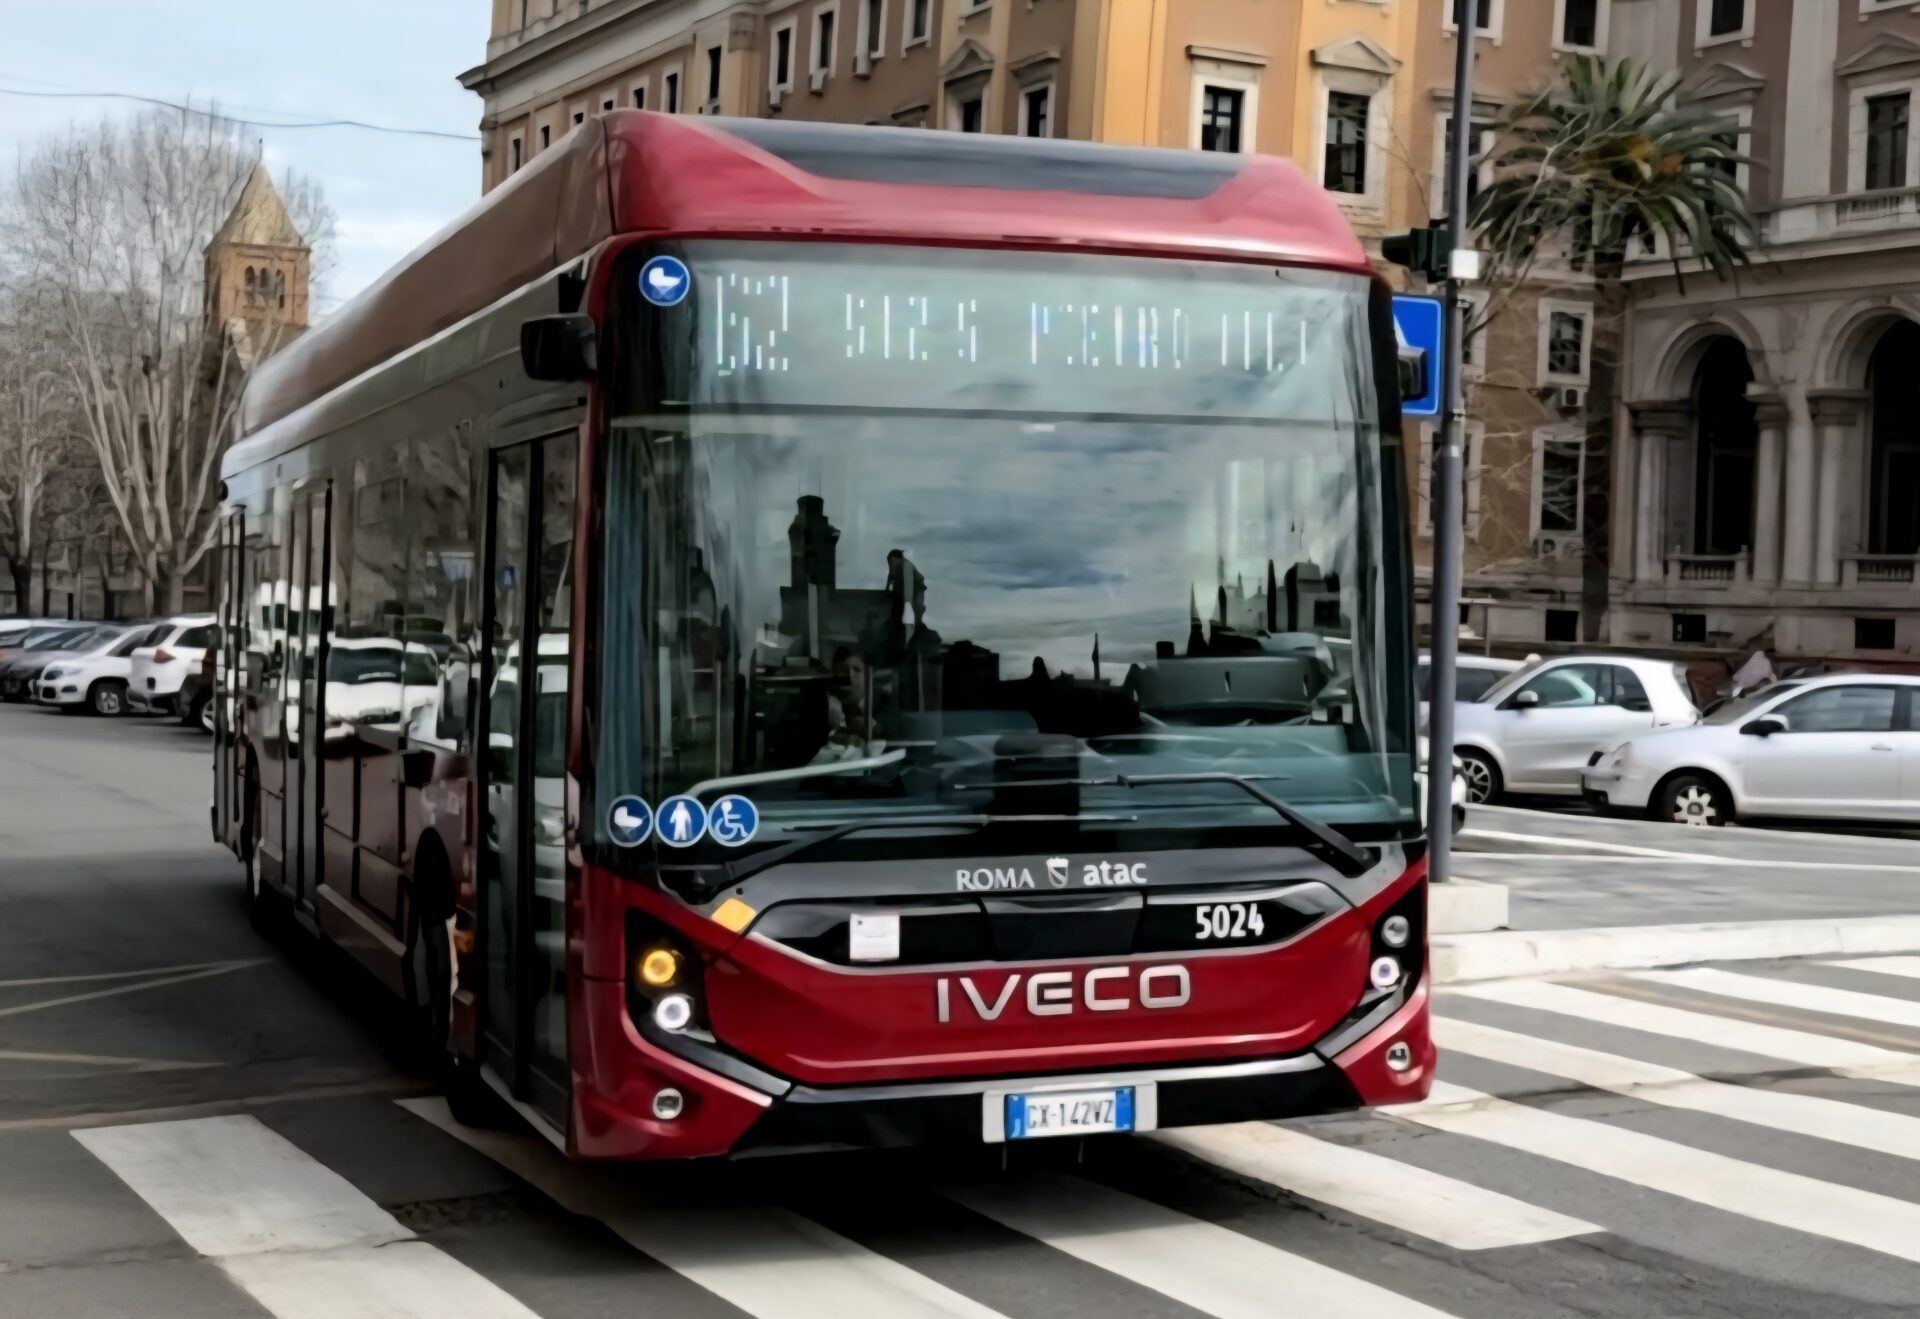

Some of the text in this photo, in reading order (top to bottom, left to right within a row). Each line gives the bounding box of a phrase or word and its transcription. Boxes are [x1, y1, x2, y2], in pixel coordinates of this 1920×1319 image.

[956, 860, 1148, 891] ROMA atac
[1195, 902, 1265, 940] 5024
[936, 964, 1191, 1024] IVECO
